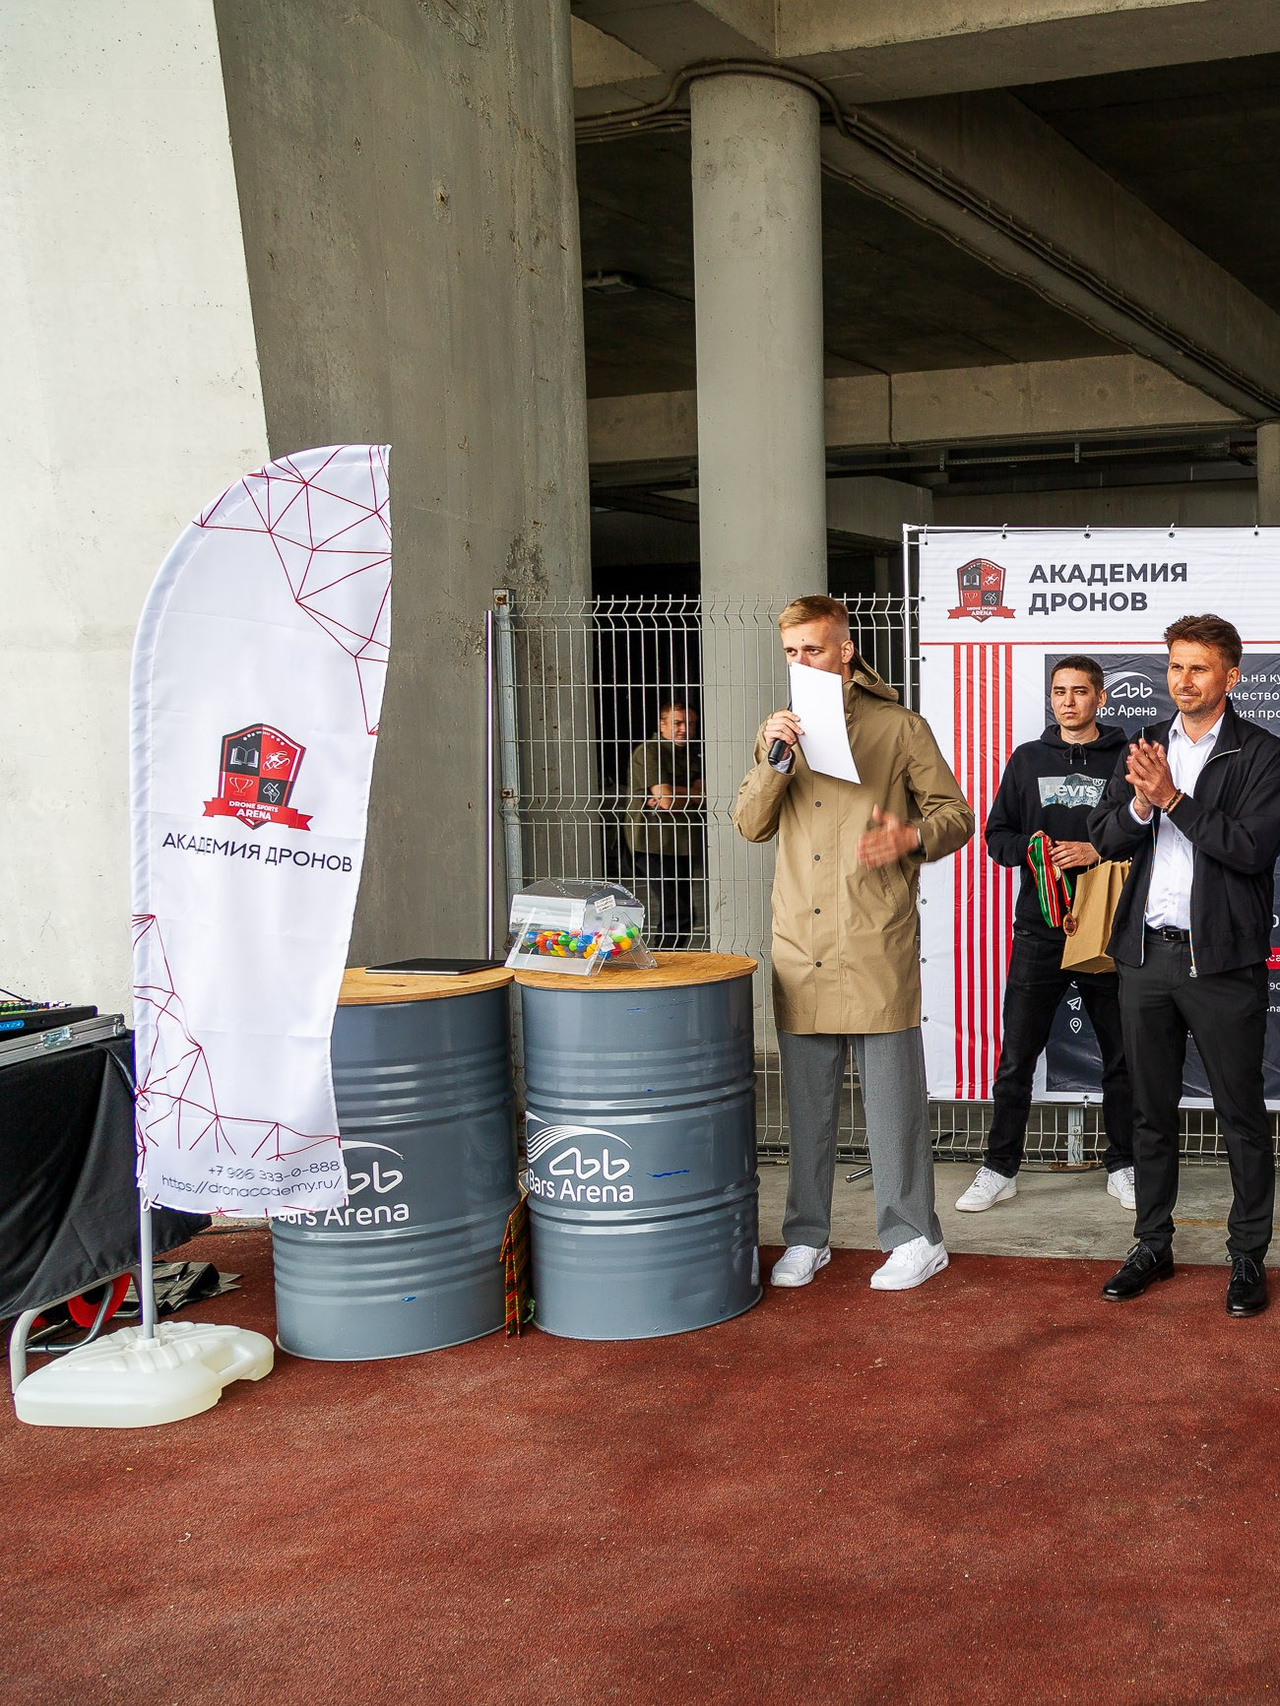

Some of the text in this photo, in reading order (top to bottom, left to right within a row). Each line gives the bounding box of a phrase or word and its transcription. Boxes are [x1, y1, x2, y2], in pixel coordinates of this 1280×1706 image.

[1029, 562, 1188, 587] АКАДЕМИЯ
[1028, 591, 1149, 616] ДРОНОВ
[1252, 674, 1266, 683] на
[1226, 692, 1280, 701] ичество
[1117, 705, 1157, 719] Арена
[229, 800, 279, 814] DRONE SPORTS
[236, 808, 272, 821] ARENA
[162, 832, 353, 873] АКАДЕМИЯ ДРОНОВ
[208, 1164, 224, 1177] +7
[258, 1160, 341, 1183] 333-0-888
[529, 1167, 635, 1203] Bars Arena
[323, 1202, 411, 1227] Arena
